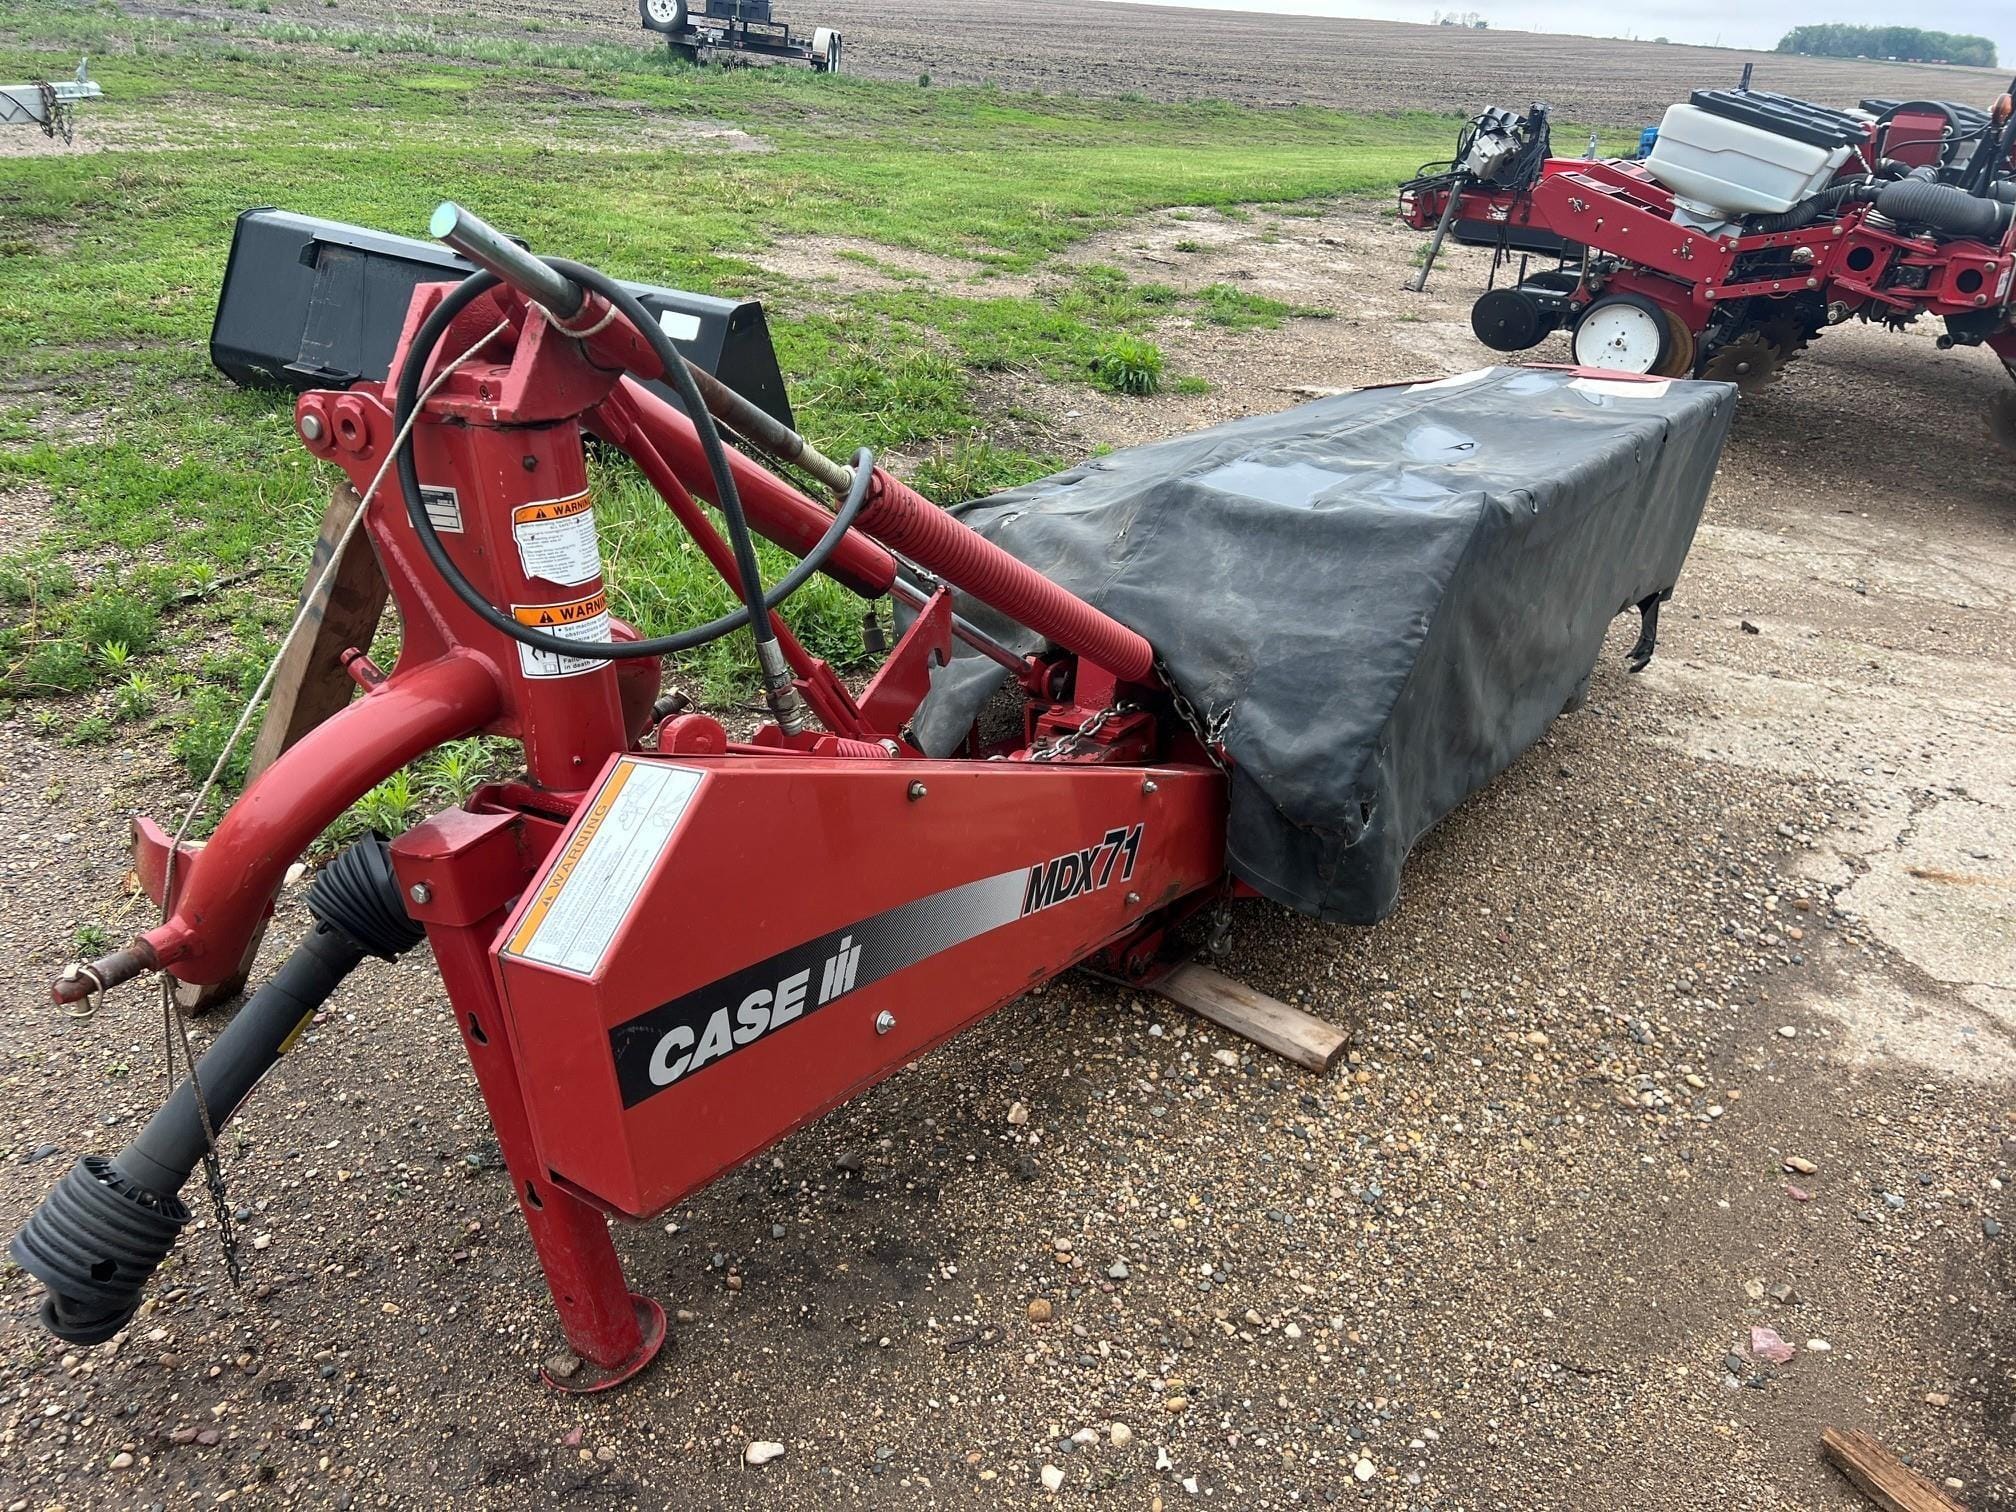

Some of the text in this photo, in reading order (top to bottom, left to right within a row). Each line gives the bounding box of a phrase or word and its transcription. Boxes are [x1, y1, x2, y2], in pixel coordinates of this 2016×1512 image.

[573, 660, 591, 669] death
[549, 805, 608, 888] WARNING
[649, 967, 811, 1086] CASE
